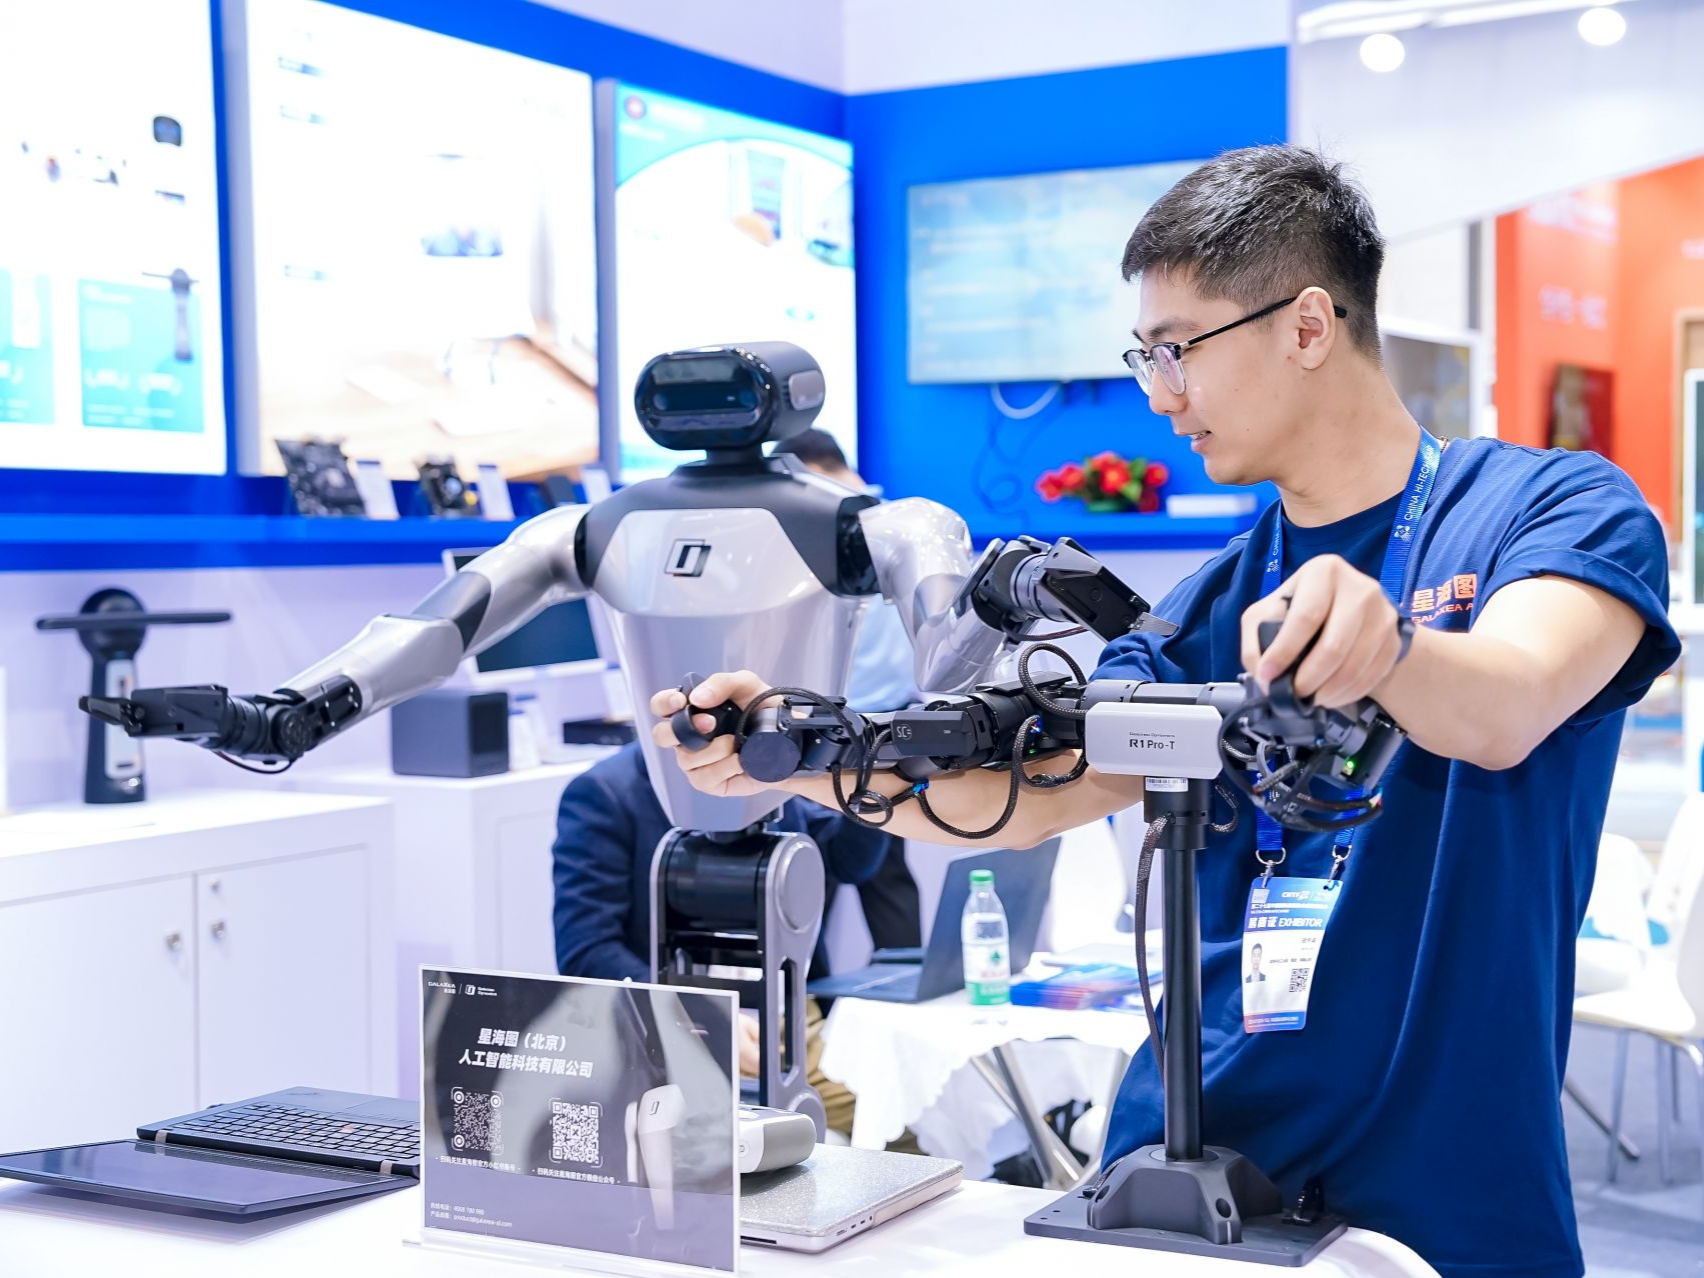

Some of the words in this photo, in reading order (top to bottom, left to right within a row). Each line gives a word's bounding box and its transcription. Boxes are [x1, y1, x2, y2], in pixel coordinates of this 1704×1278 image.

[1404, 495, 1420, 521] CHINA
[1411, 603, 1464, 624] GALAXEA
[1129, 739, 1144, 748] R1
[1147, 739, 1175, 750] Pro-T
[1278, 917, 1324, 928] EXHIBITOR
[477, 1027, 567, 1052] 星海图（北京）
[458, 1049, 594, 1078] 人工智能科技有限公司
